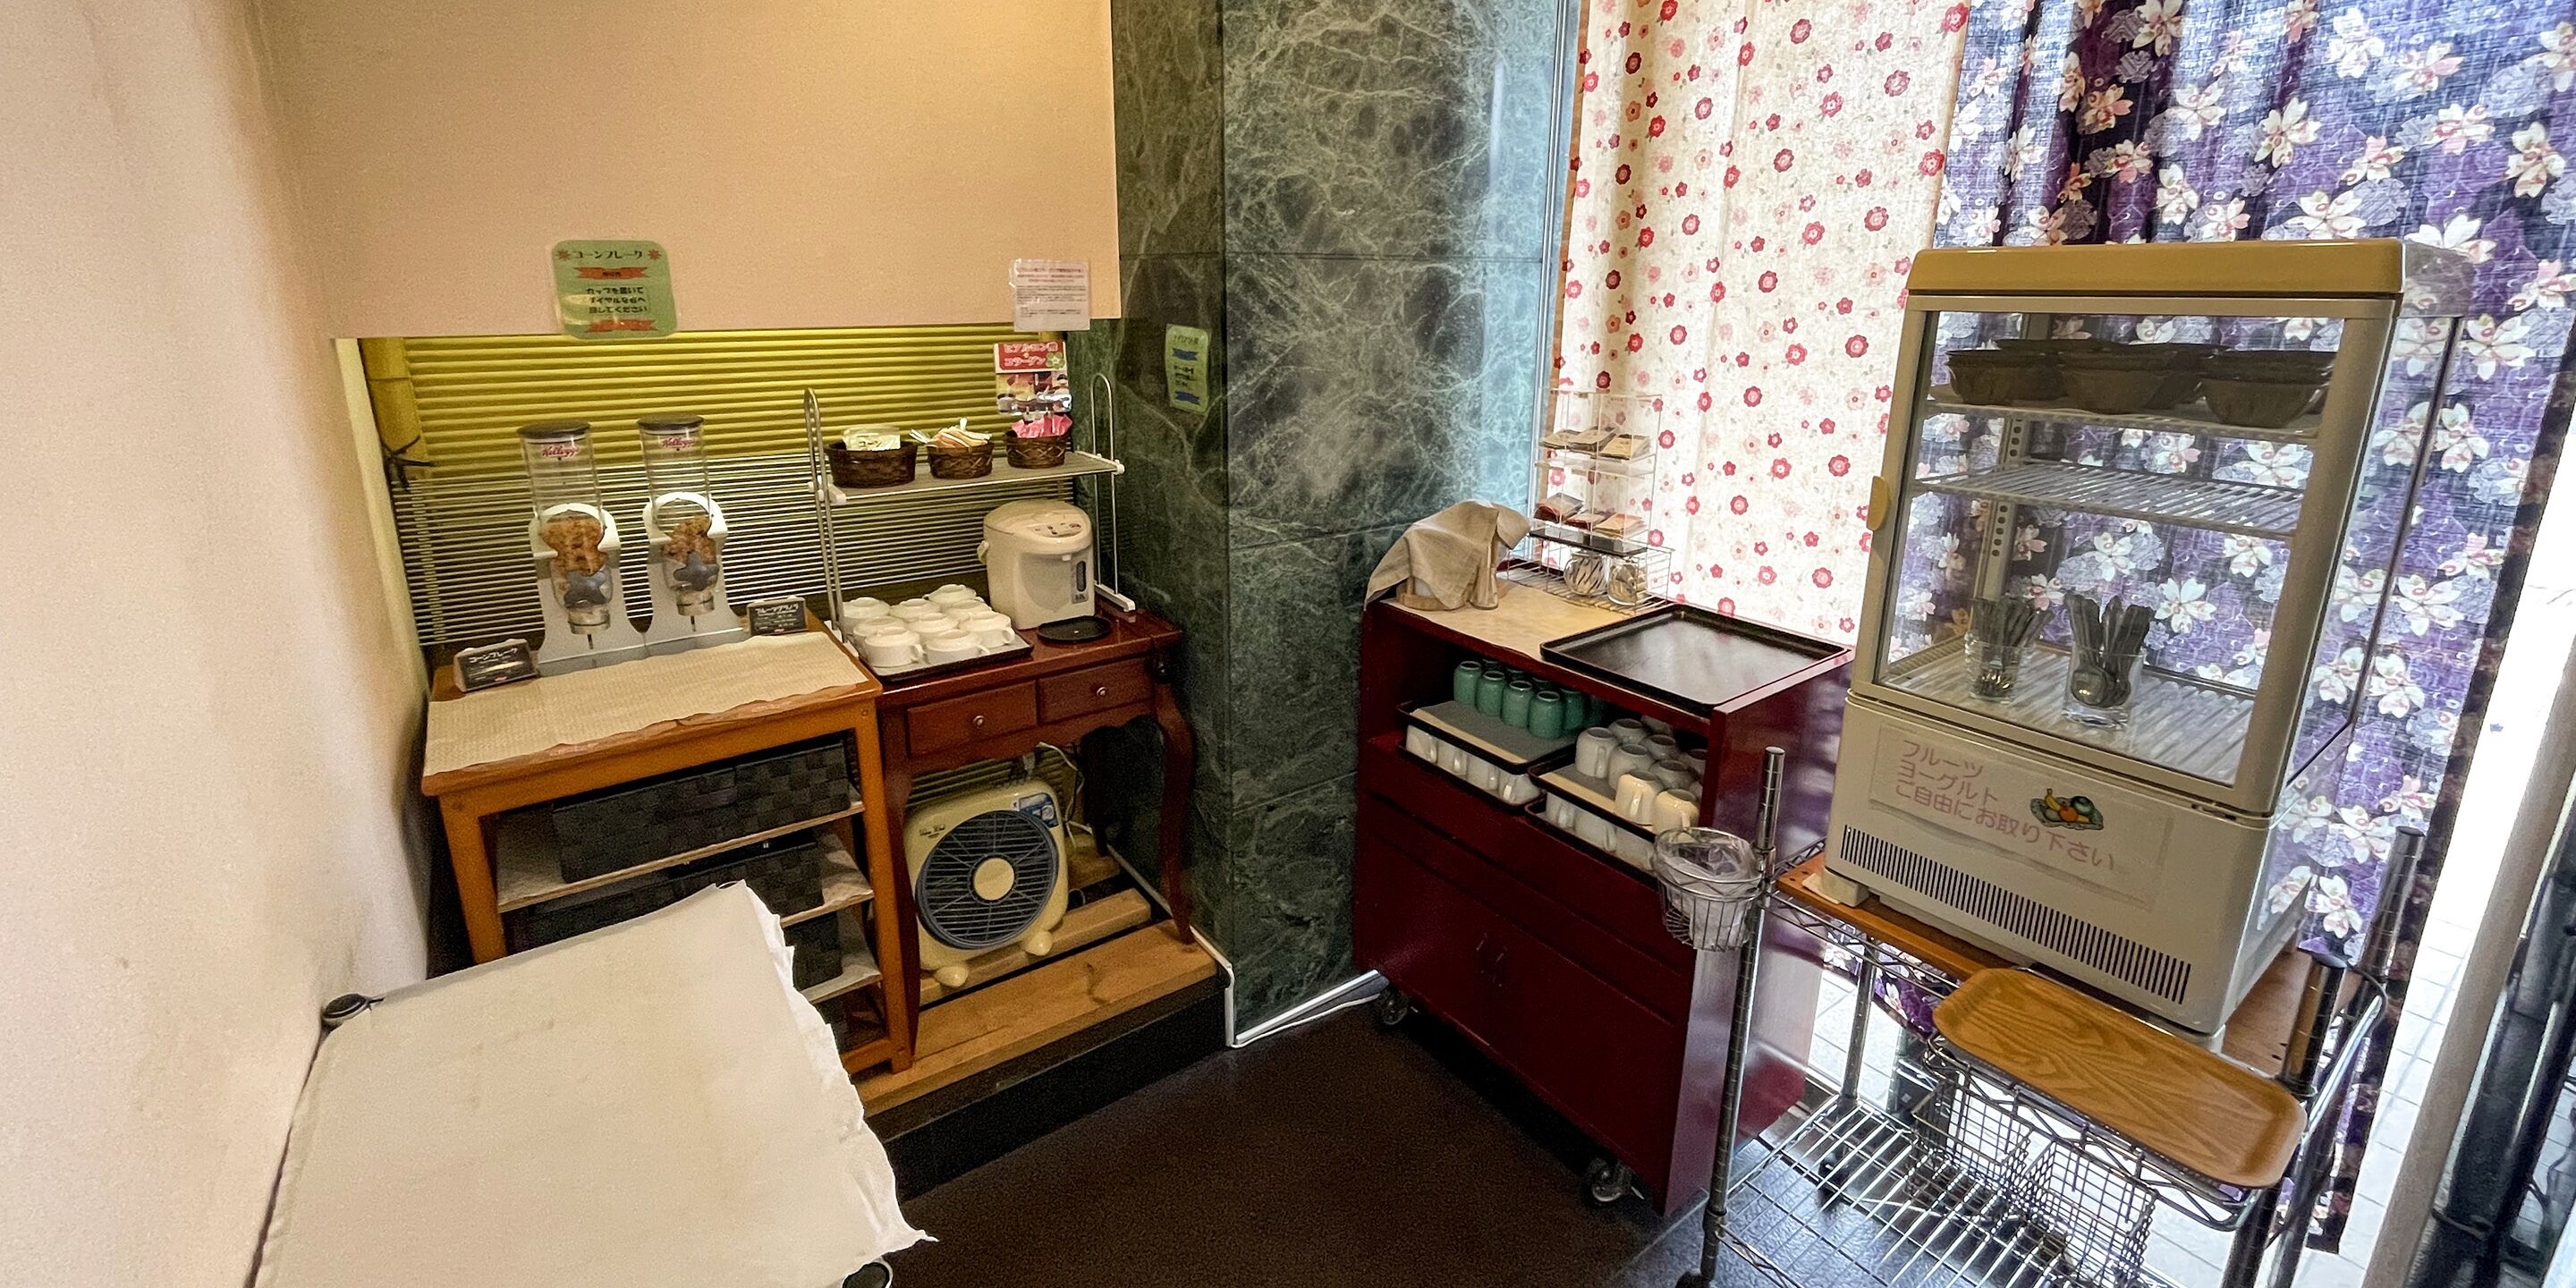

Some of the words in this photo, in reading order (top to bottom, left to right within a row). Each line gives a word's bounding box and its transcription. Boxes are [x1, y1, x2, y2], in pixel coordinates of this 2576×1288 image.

[572, 250, 643, 259] コーンフレーク
[1902, 740, 1984, 778] フルーツ
[1899, 759, 1998, 806] ヨーグルト
[1895, 778, 2115, 871] ご自由にお取り下さい
